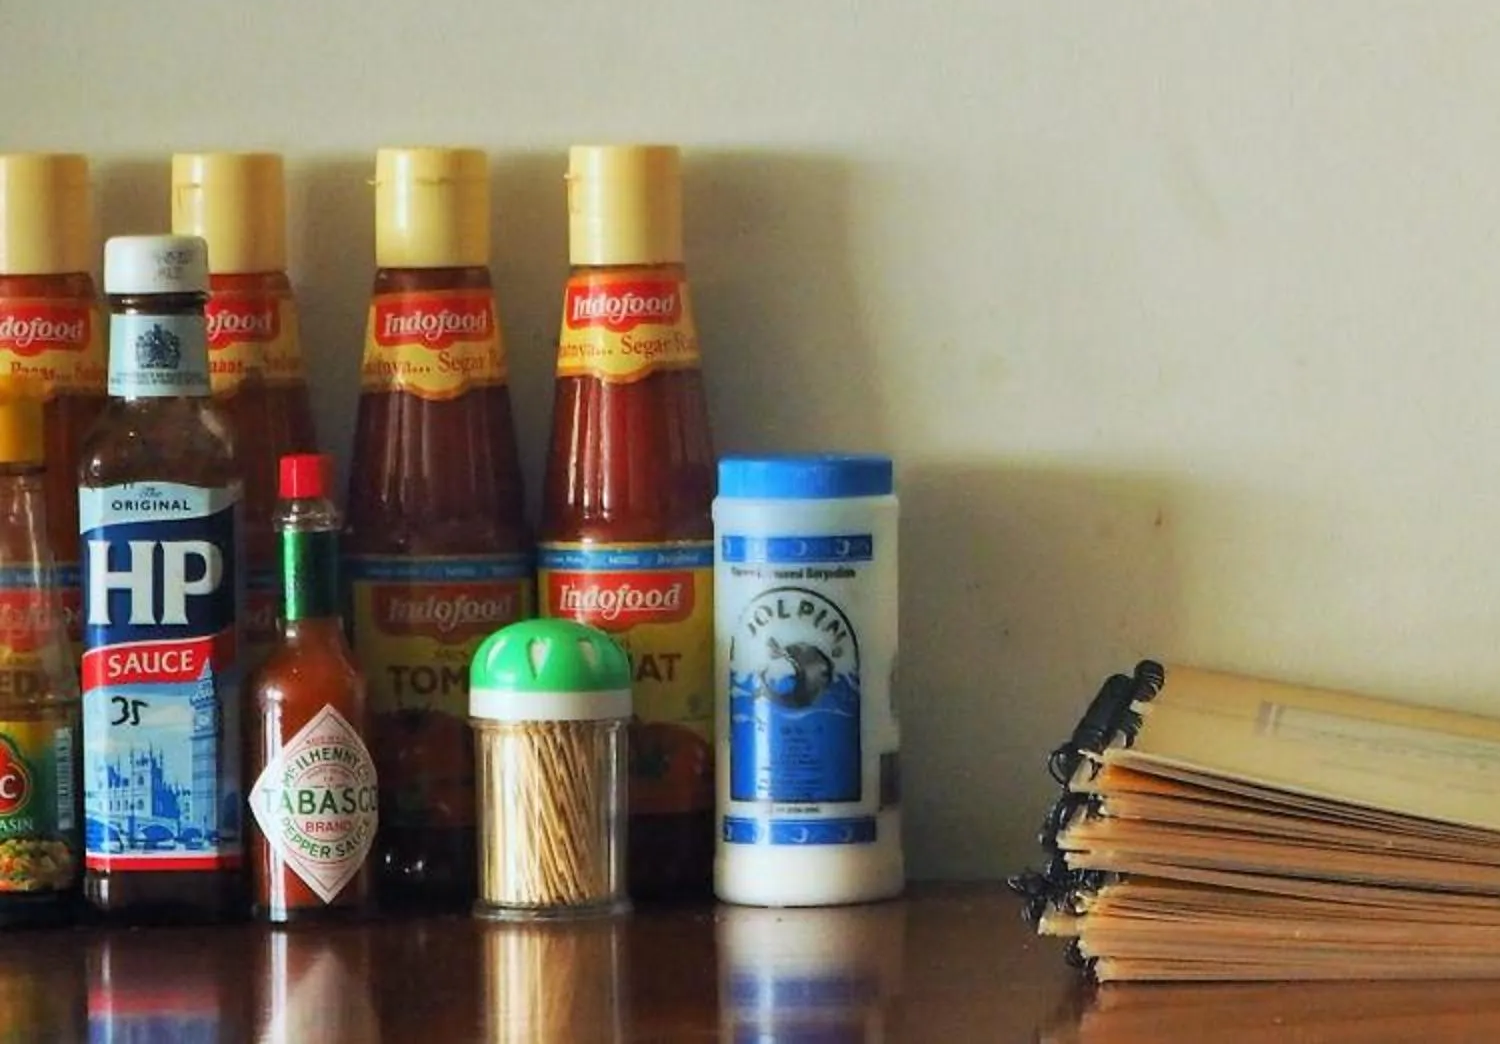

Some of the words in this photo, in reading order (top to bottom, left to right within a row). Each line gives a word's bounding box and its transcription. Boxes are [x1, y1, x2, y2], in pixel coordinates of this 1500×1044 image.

[573, 292, 674, 324] Indofood
[0, 316, 84, 347] dofood
[384, 309, 487, 341] Indofood
[111, 500, 192, 511] ORIGINAL
[88, 540, 223, 625] HP
[559, 583, 682, 620] Indofood
[108, 649, 195, 677] SAUCE
[387, 664, 470, 695] TOM
[111, 695, 149, 727] 35
[304, 821, 353, 834] BRAND
